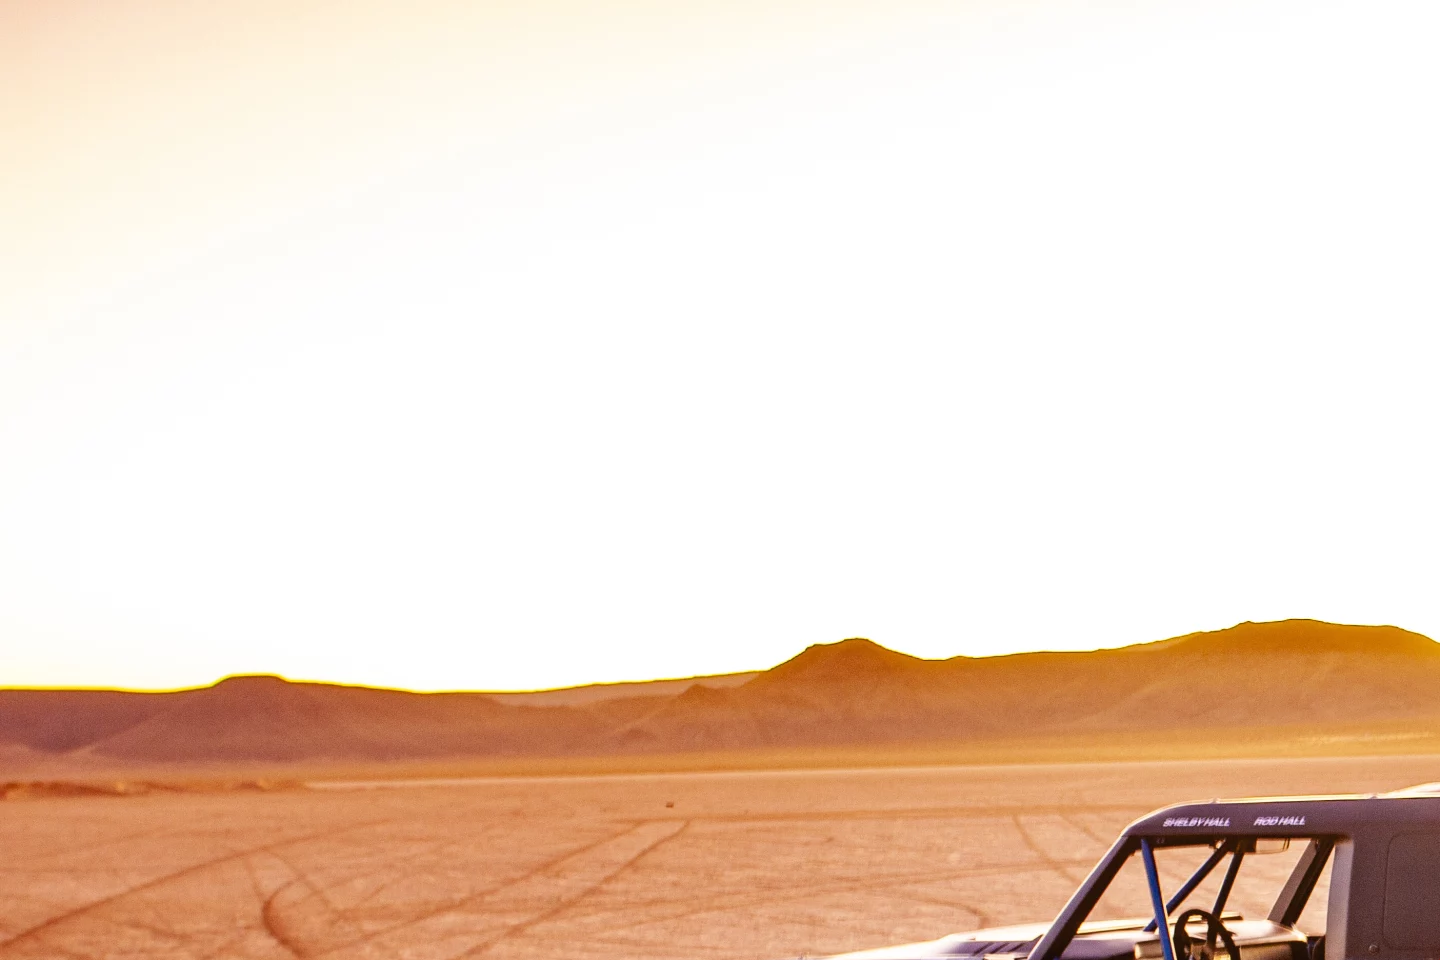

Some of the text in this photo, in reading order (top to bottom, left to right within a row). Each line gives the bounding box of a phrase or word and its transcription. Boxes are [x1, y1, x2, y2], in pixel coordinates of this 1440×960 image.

[1163, 817, 1230, 827] SHELBY HALL
[1254, 816, 1305, 826] ROD HALL
